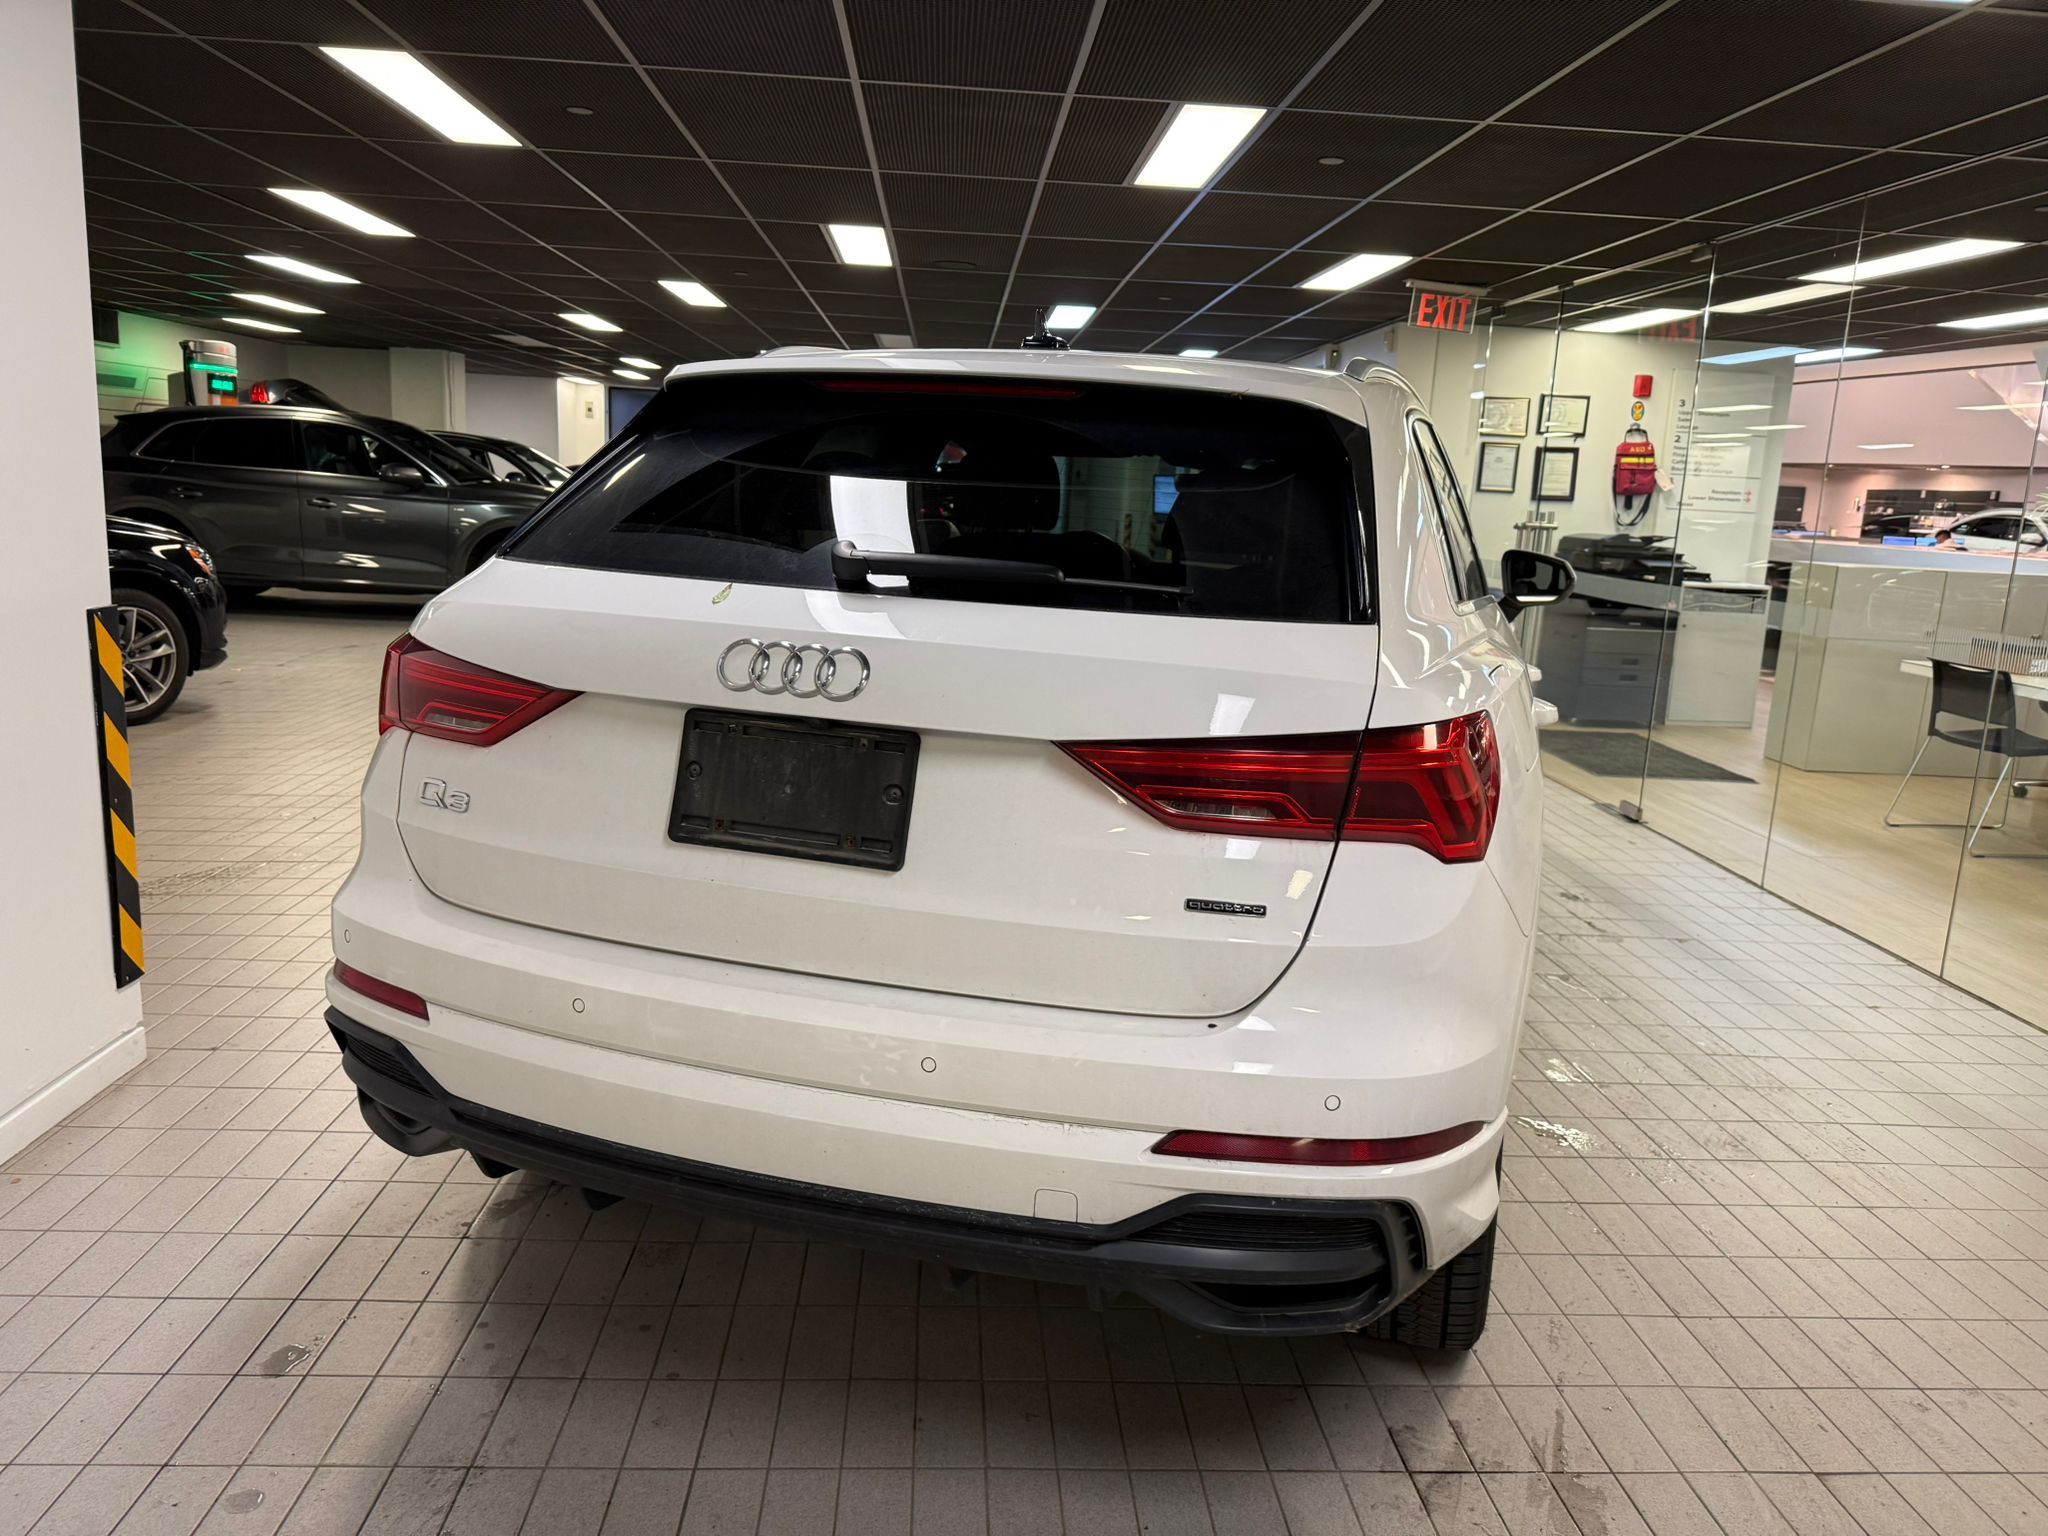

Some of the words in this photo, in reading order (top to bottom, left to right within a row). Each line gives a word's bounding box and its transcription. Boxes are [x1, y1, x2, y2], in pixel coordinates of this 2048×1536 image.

[1416, 293, 1473, 331] EXIT
[1679, 399, 1686, 408] 3
[1673, 434, 1681, 443] 2
[418, 776, 471, 814] Q3
[1187, 900, 1265, 915] quattro
